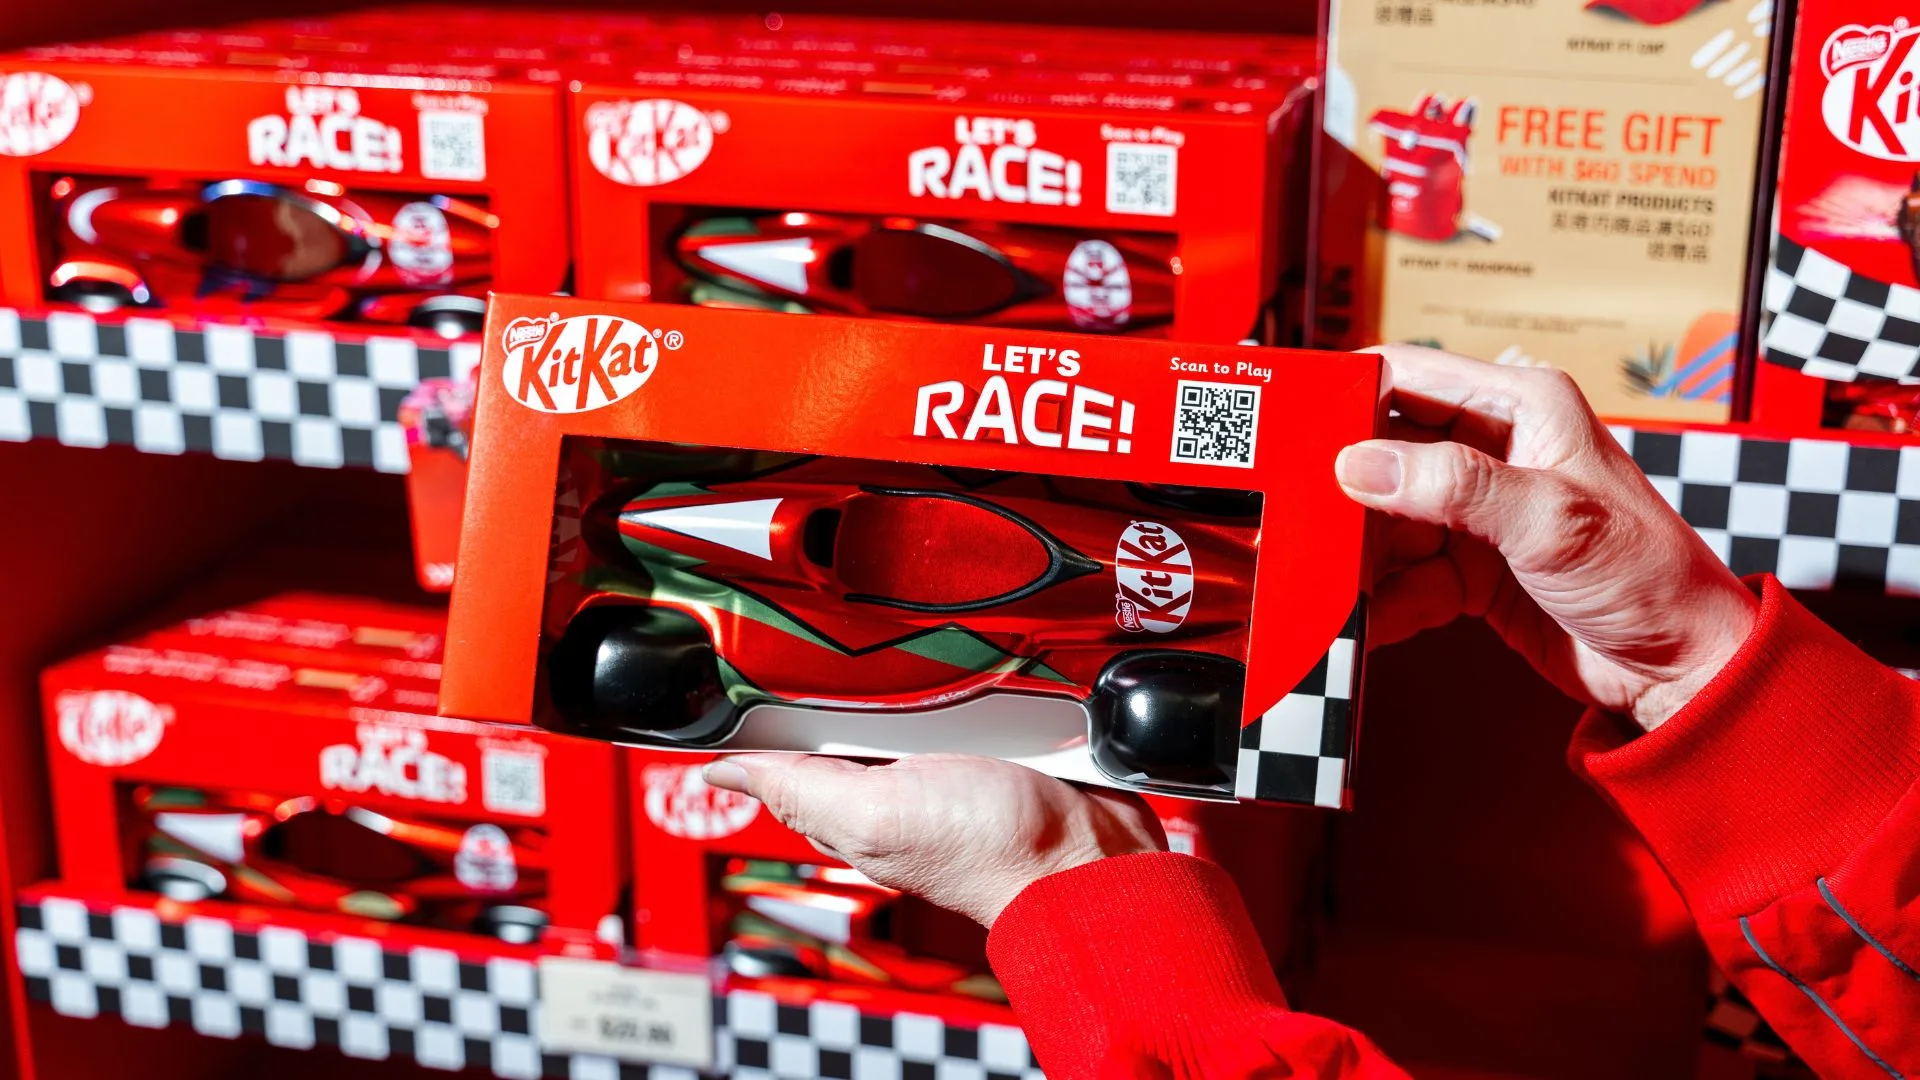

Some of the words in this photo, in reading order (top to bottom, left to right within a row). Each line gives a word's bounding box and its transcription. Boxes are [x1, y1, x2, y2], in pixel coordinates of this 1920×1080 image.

[1848, 33, 1920, 155] Ki
[248, 114, 402, 172] RACE!
[955, 115, 1037, 147] LET'S
[1497, 105, 1606, 151] FREE
[1624, 111, 1723, 157] GIFT
[908, 144, 1083, 206] RACE!
[1501, 156, 1565, 177] WITH
[1575, 158, 1620, 182] $60
[1630, 161, 1718, 189] SPEND
[1615, 190, 1715, 214] PRODUCTS
[517, 317, 654, 411] KitKat
[982, 343, 1081, 377] LET'S
[1170, 357, 1208, 373] Scan
[1214, 358, 1230, 375] to
[1235, 361, 1273, 383] Play
[913, 375, 1136, 455] RACE!
[1117, 523, 1192, 625] KitKat
